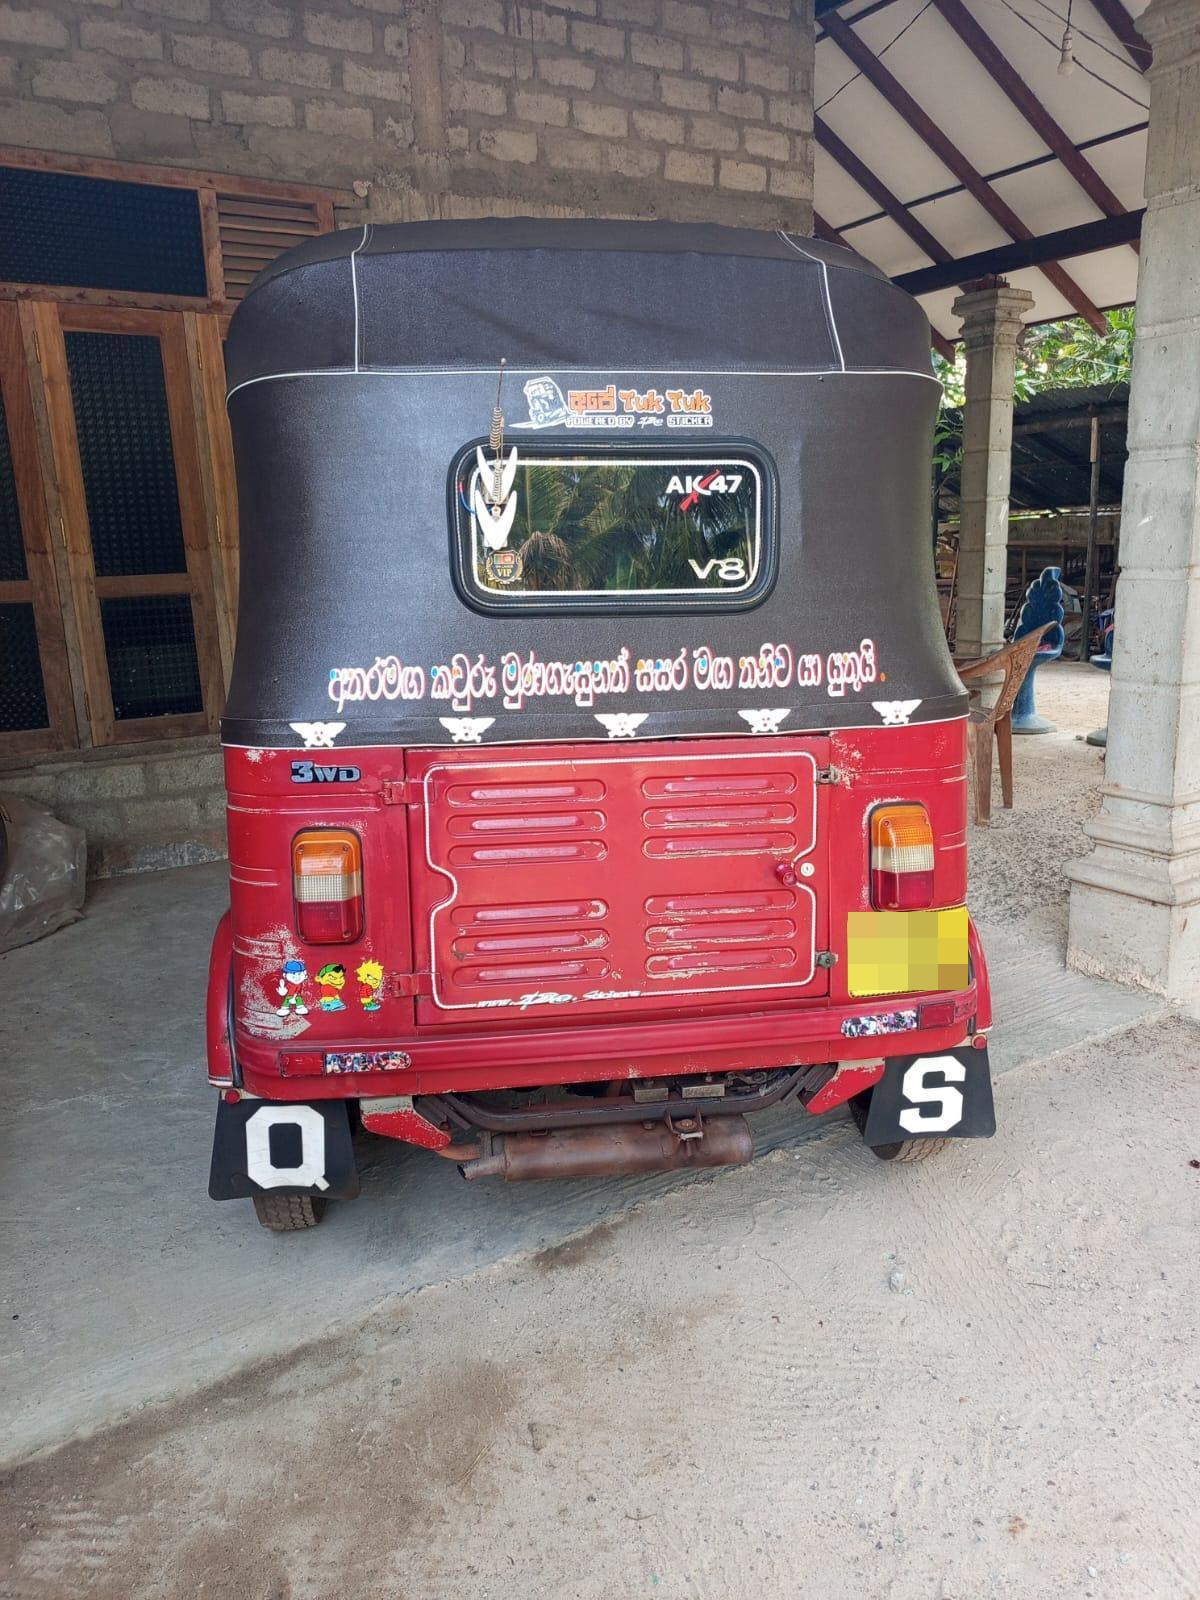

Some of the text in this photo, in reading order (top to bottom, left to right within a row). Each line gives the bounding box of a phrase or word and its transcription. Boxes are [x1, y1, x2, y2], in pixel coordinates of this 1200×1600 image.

[619, 389, 665, 412] Tuk
[666, 389, 712, 411] Tuk
[667, 415, 713, 427] STICKER
[665, 474, 743, 496] AK47
[496, 568, 513, 577] VIP
[688, 557, 746, 580] V8
[634, 648, 689, 692] සසර
[290, 760, 361, 783] 3WD
[899, 1055, 967, 1133] S
